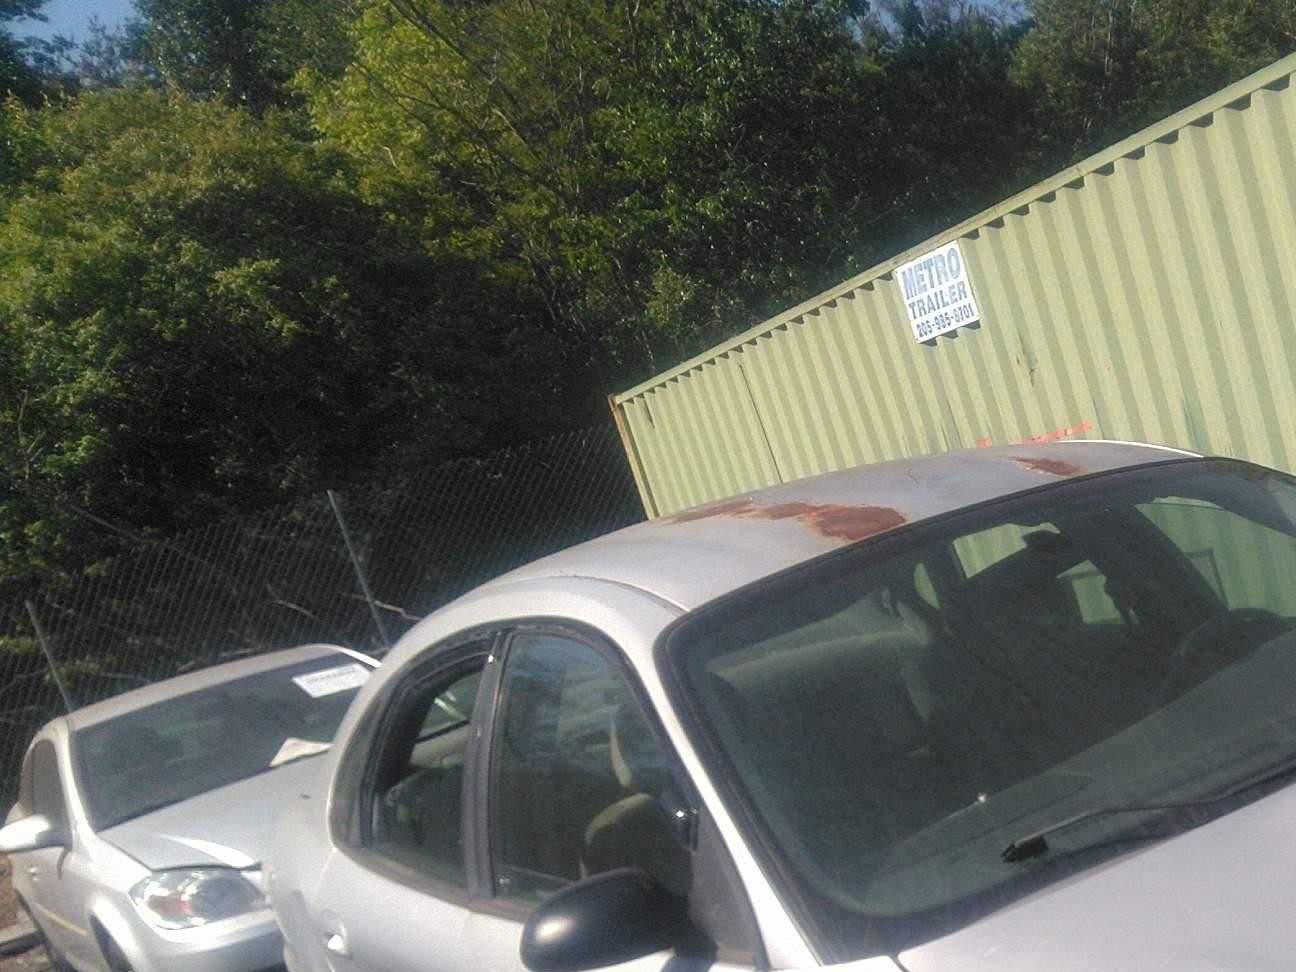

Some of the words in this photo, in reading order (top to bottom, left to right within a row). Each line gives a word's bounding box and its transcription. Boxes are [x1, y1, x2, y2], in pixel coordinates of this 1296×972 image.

[901, 247, 961, 300] METRO
[908, 280, 968, 320] TRAILER
[916, 302, 975, 338] 205-985-8701
